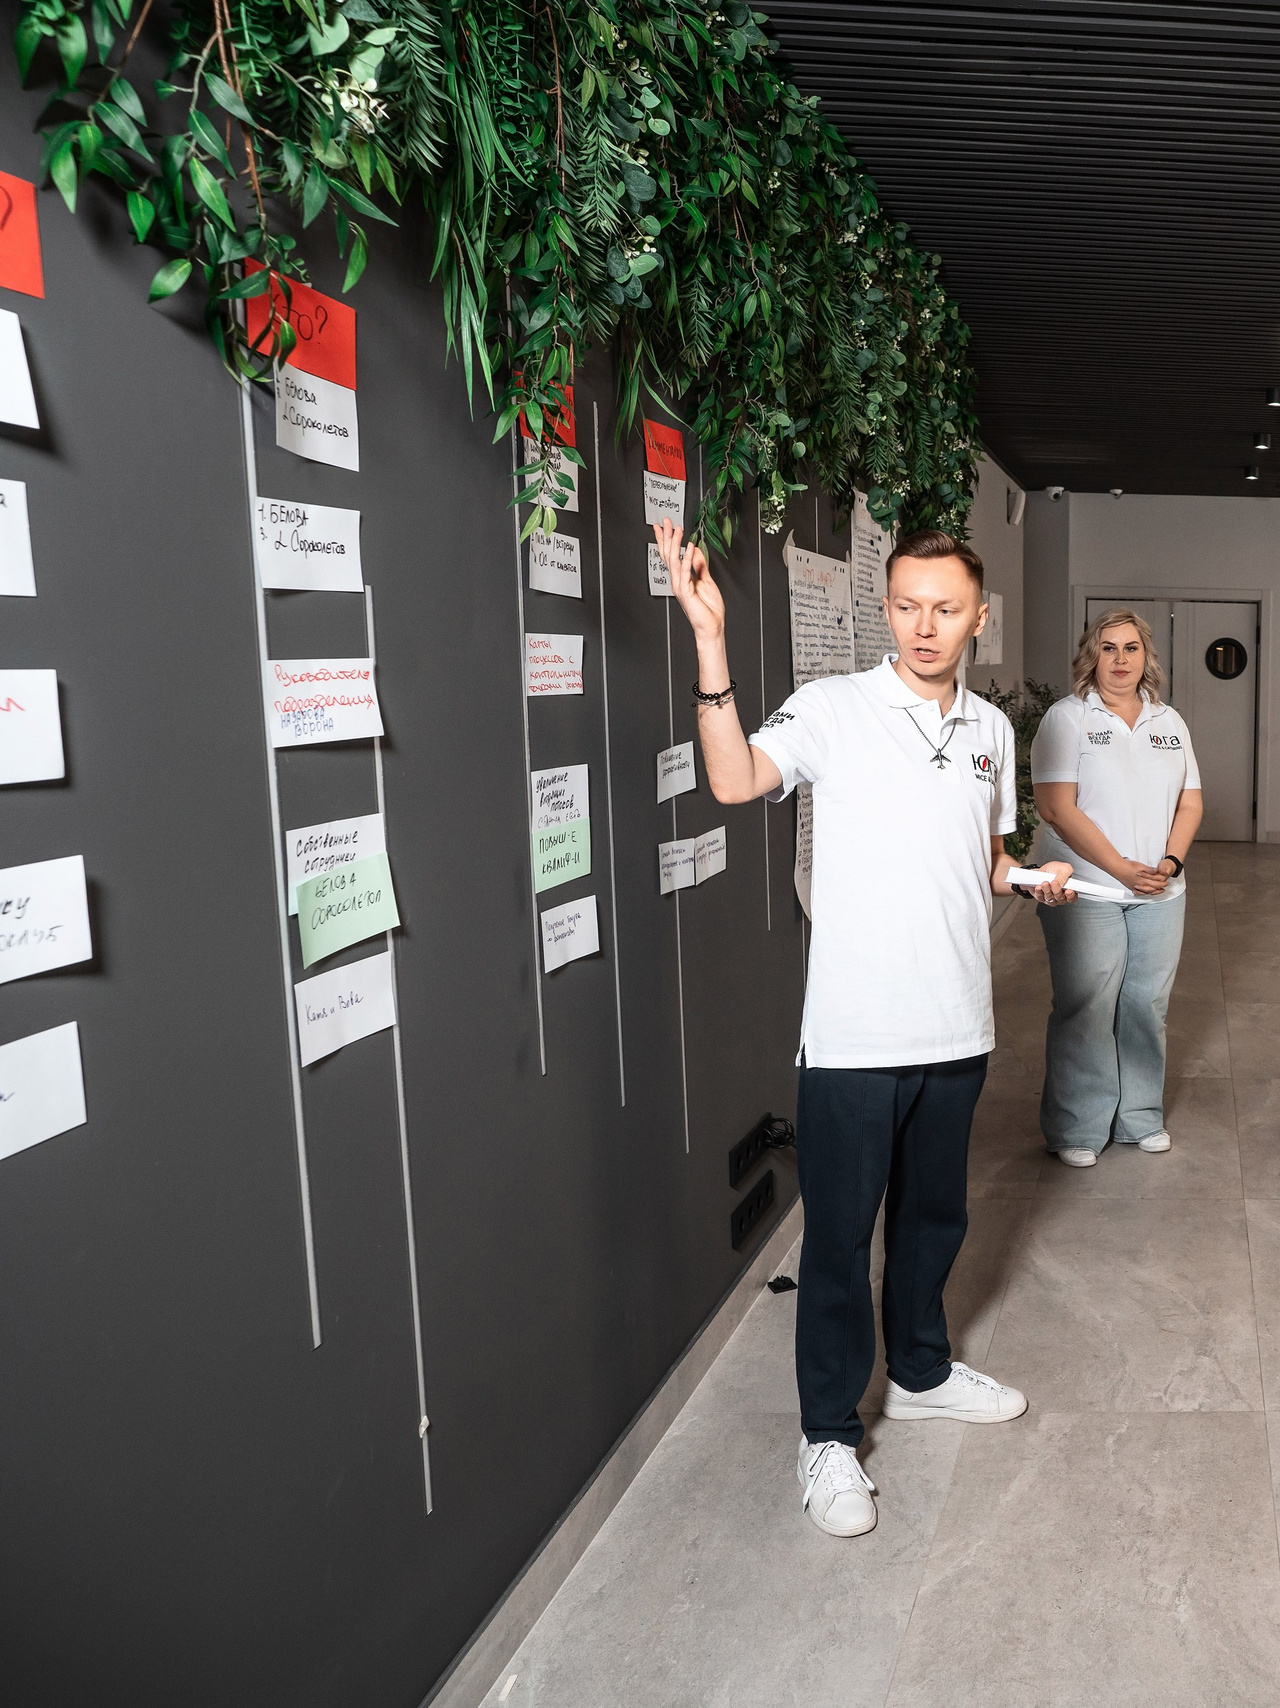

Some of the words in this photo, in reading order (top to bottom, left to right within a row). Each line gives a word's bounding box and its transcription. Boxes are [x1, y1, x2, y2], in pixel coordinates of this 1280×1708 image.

[270, 504, 309, 528] БЕЛОВА
[290, 530, 346, 559] Сороколетов
[295, 718, 334, 738] ВОРОНА
[305, 1004, 328, 1025] Катя
[338, 990, 364, 1009] Вова
